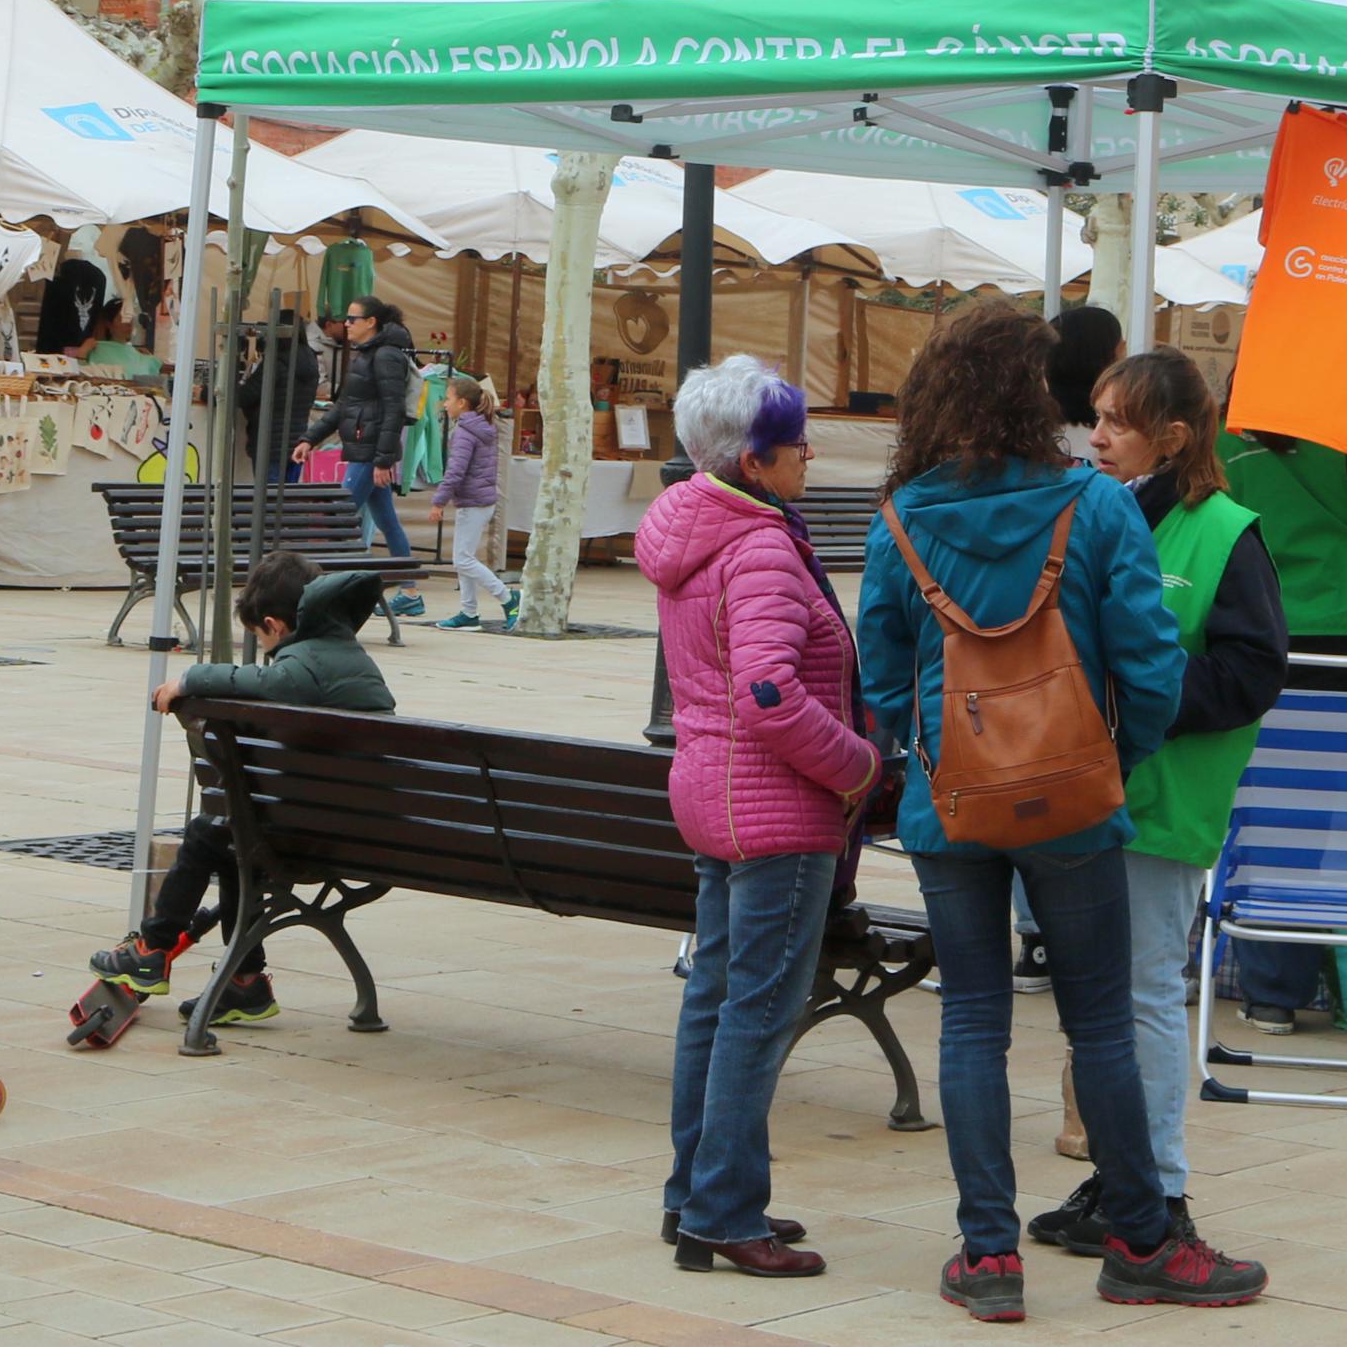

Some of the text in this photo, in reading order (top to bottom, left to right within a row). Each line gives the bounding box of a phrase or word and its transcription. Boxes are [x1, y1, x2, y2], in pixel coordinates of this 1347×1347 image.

[221, 38, 440, 75] ASOCIACIÓN
[130, 122, 160, 134] DE
[1318, 263, 1345, 275] contra
[1315, 272, 1326, 281] en
